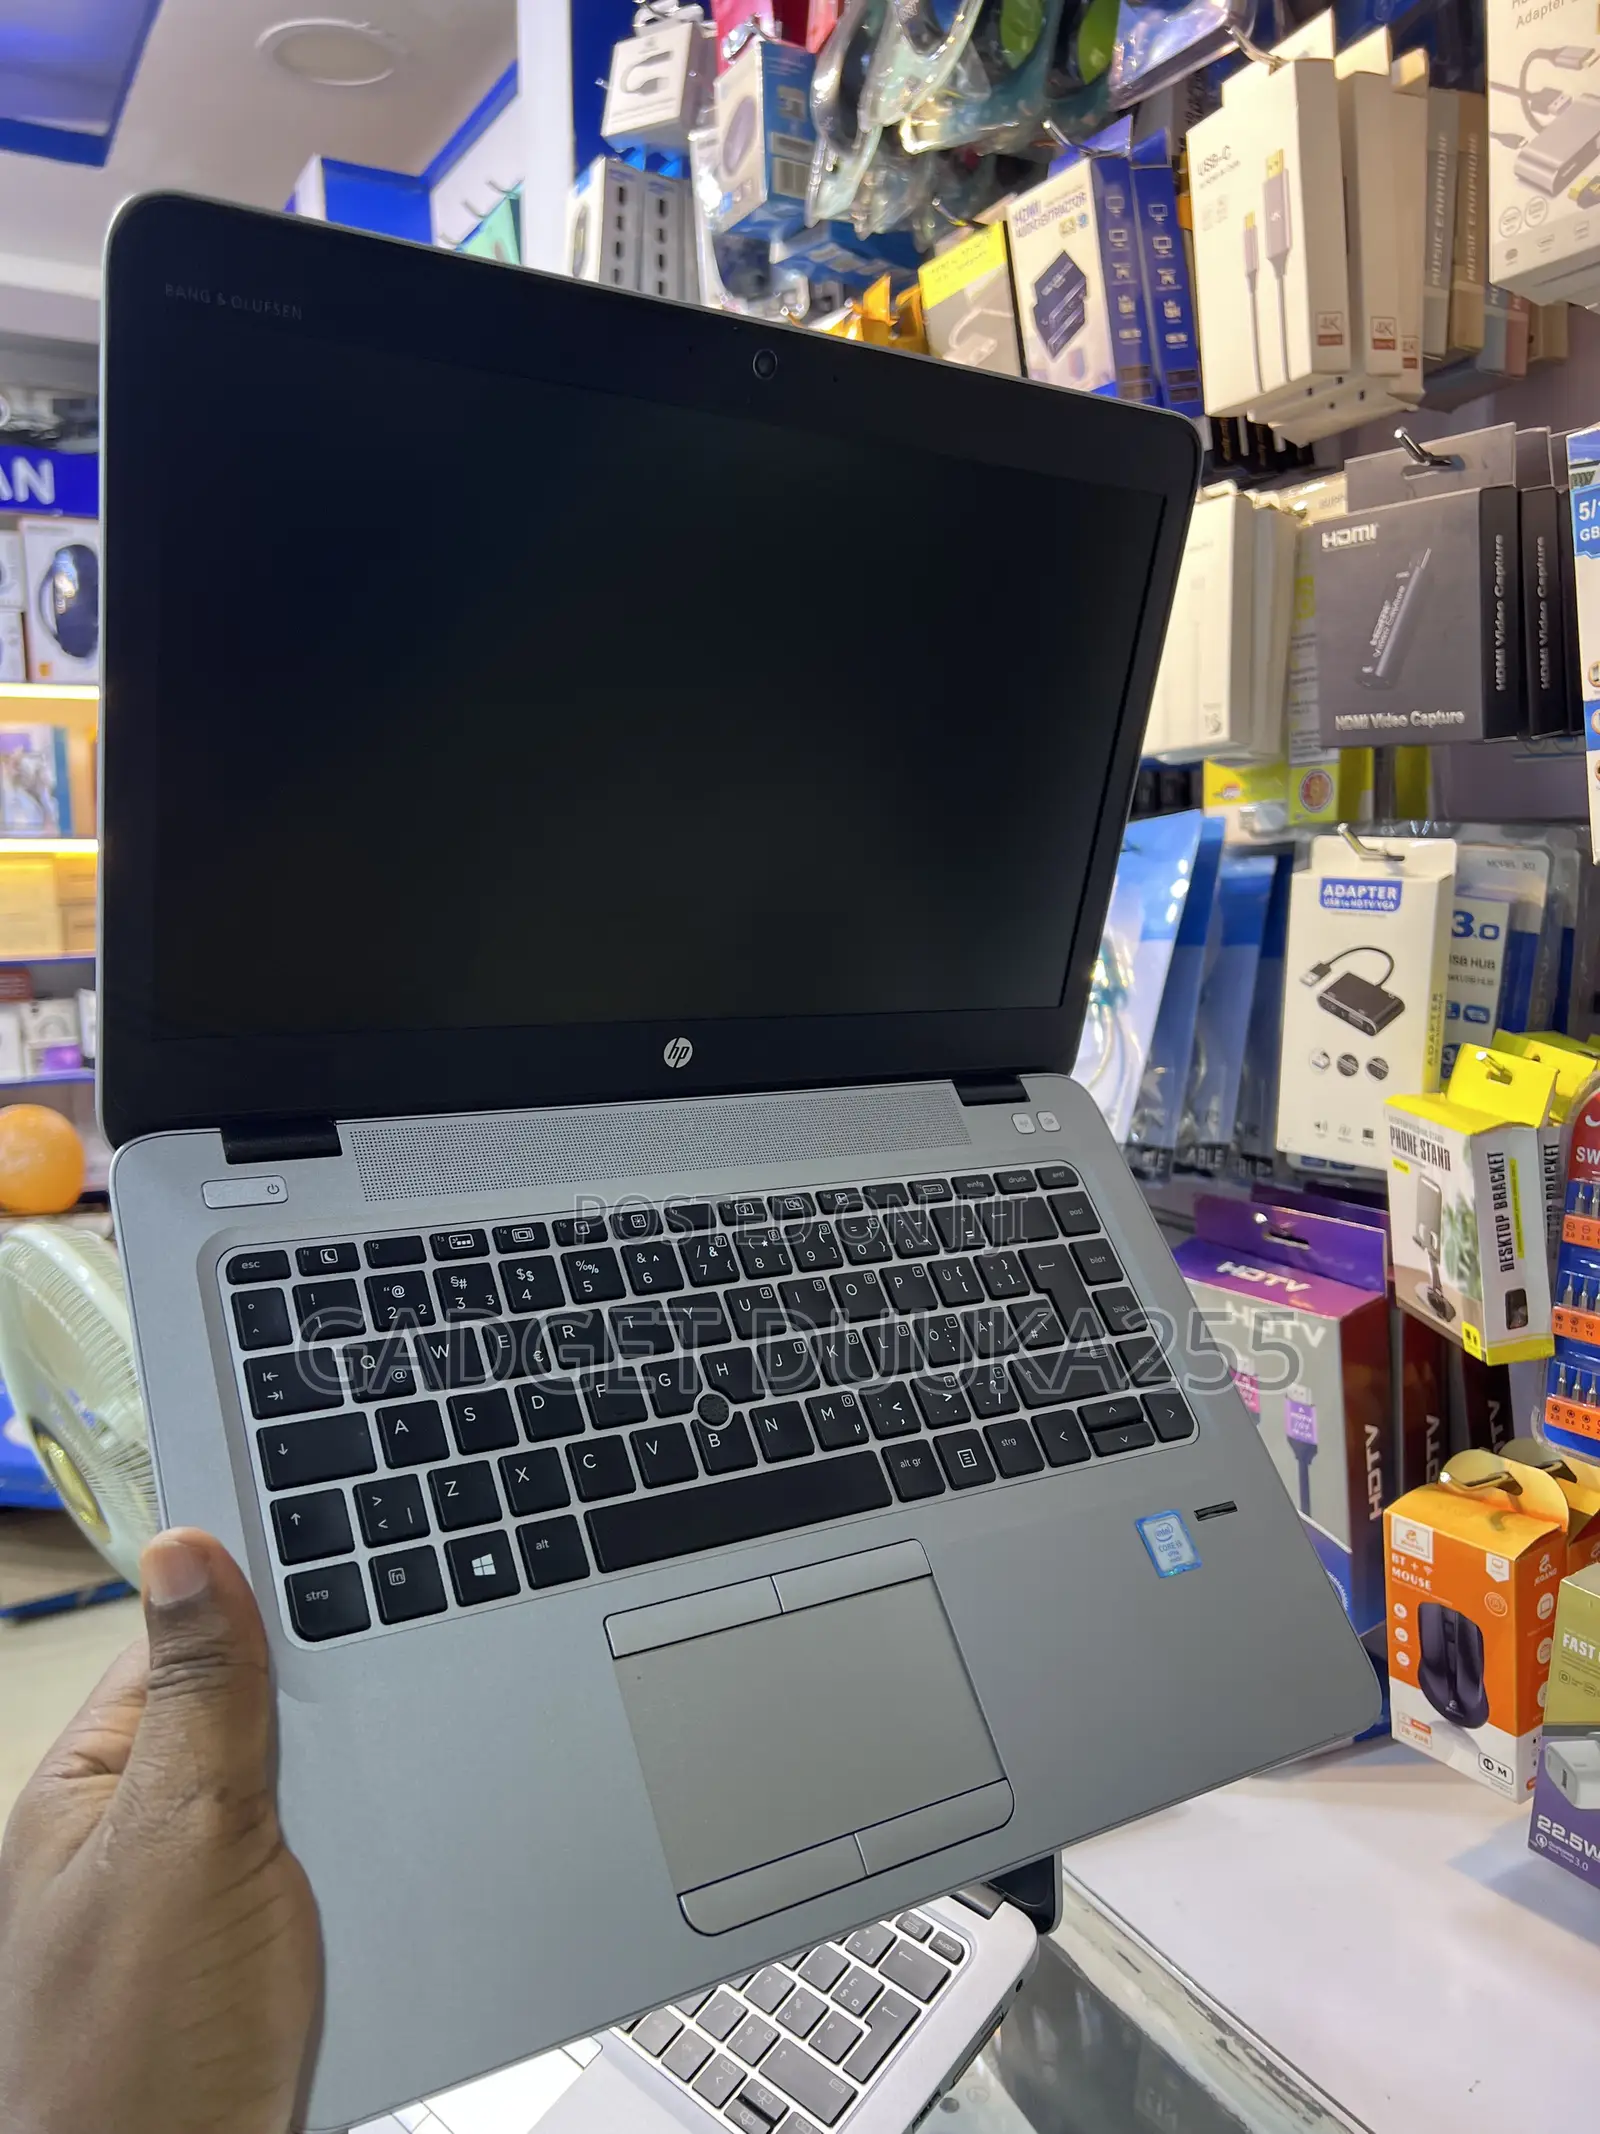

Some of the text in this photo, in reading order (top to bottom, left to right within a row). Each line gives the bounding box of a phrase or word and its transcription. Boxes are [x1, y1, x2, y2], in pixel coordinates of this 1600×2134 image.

[165, 283, 211, 304] BANG
[231, 295, 302, 320] OLUFSEN
[1494, 534, 1506, 597] Capture
[1370, 712, 1409, 730] Video
[1410, 709, 1466, 730] Capture
[1323, 883, 1398, 900] ADAPTER
[1470, 957, 1496, 971] HUB
[667, 1037, 691, 1068] hp
[1389, 1125, 1418, 1157] PHONE
[1420, 1138, 1451, 1172] STAND
[1008, 1174, 1028, 1184] druck
[1487, 1151, 1515, 1272] DESKTOP BRACKET
[755, 1257, 765, 1269] 8
[806, 1250, 816, 1262] 9
[241, 1260, 261, 1269] esc
[699, 1264, 708, 1276] 7
[643, 1272, 653, 1284] 6
[894, 1276, 904, 1289] P
[1216, 1261, 1312, 1292] HDTV
[583, 1280, 593, 1293] 5
[485, 1295, 495, 1305] 3
[521, 1289, 532, 1301] 4
[418, 1304, 428, 1315] 2
[455, 1298, 466, 1310] 3
[739, 1298, 751, 1312] U
[387, 1306, 398, 1319] 2
[682, 1306, 693, 1320] Y
[624, 1315, 634, 1329] T
[1225, 1300, 1327, 1348] HDTV
[561, 1325, 576, 1339] R
[498, 1335, 511, 1349] E
[878, 1336, 889, 1349] L
[430, 1344, 449, 1359] W
[533, 1350, 544, 1362] €
[826, 1344, 839, 1358] K
[360, 1355, 376, 1369] Q
[775, 1353, 783, 1367] J
[716, 1362, 729, 1377] H
[658, 1372, 672, 1387] G
[595, 1383, 606, 1398] F
[531, 1395, 545, 1410] D
[463, 1407, 476, 1422] S
[821, 1406, 835, 1421] M
[395, 1419, 409, 1435] A
[764, 1417, 779, 1432] N
[645, 1440, 658, 1455] V
[708, 1433, 721, 1448] B
[1001, 1437, 1017, 1447] strg
[1426, 1414, 1440, 1484] DTV
[583, 1454, 597, 1469] C
[900, 1457, 922, 1468] alt gr
[514, 1466, 530, 1483] X
[1364, 1424, 1382, 1521] HDTV
[444, 1480, 460, 1497] Z
[535, 1538, 550, 1550] alt
[1391, 1552, 1406, 1566] BT
[1391, 1566, 1432, 1592] MOUSE
[305, 1589, 329, 1602] strg
[1562, 1632, 1596, 1660] FAST
